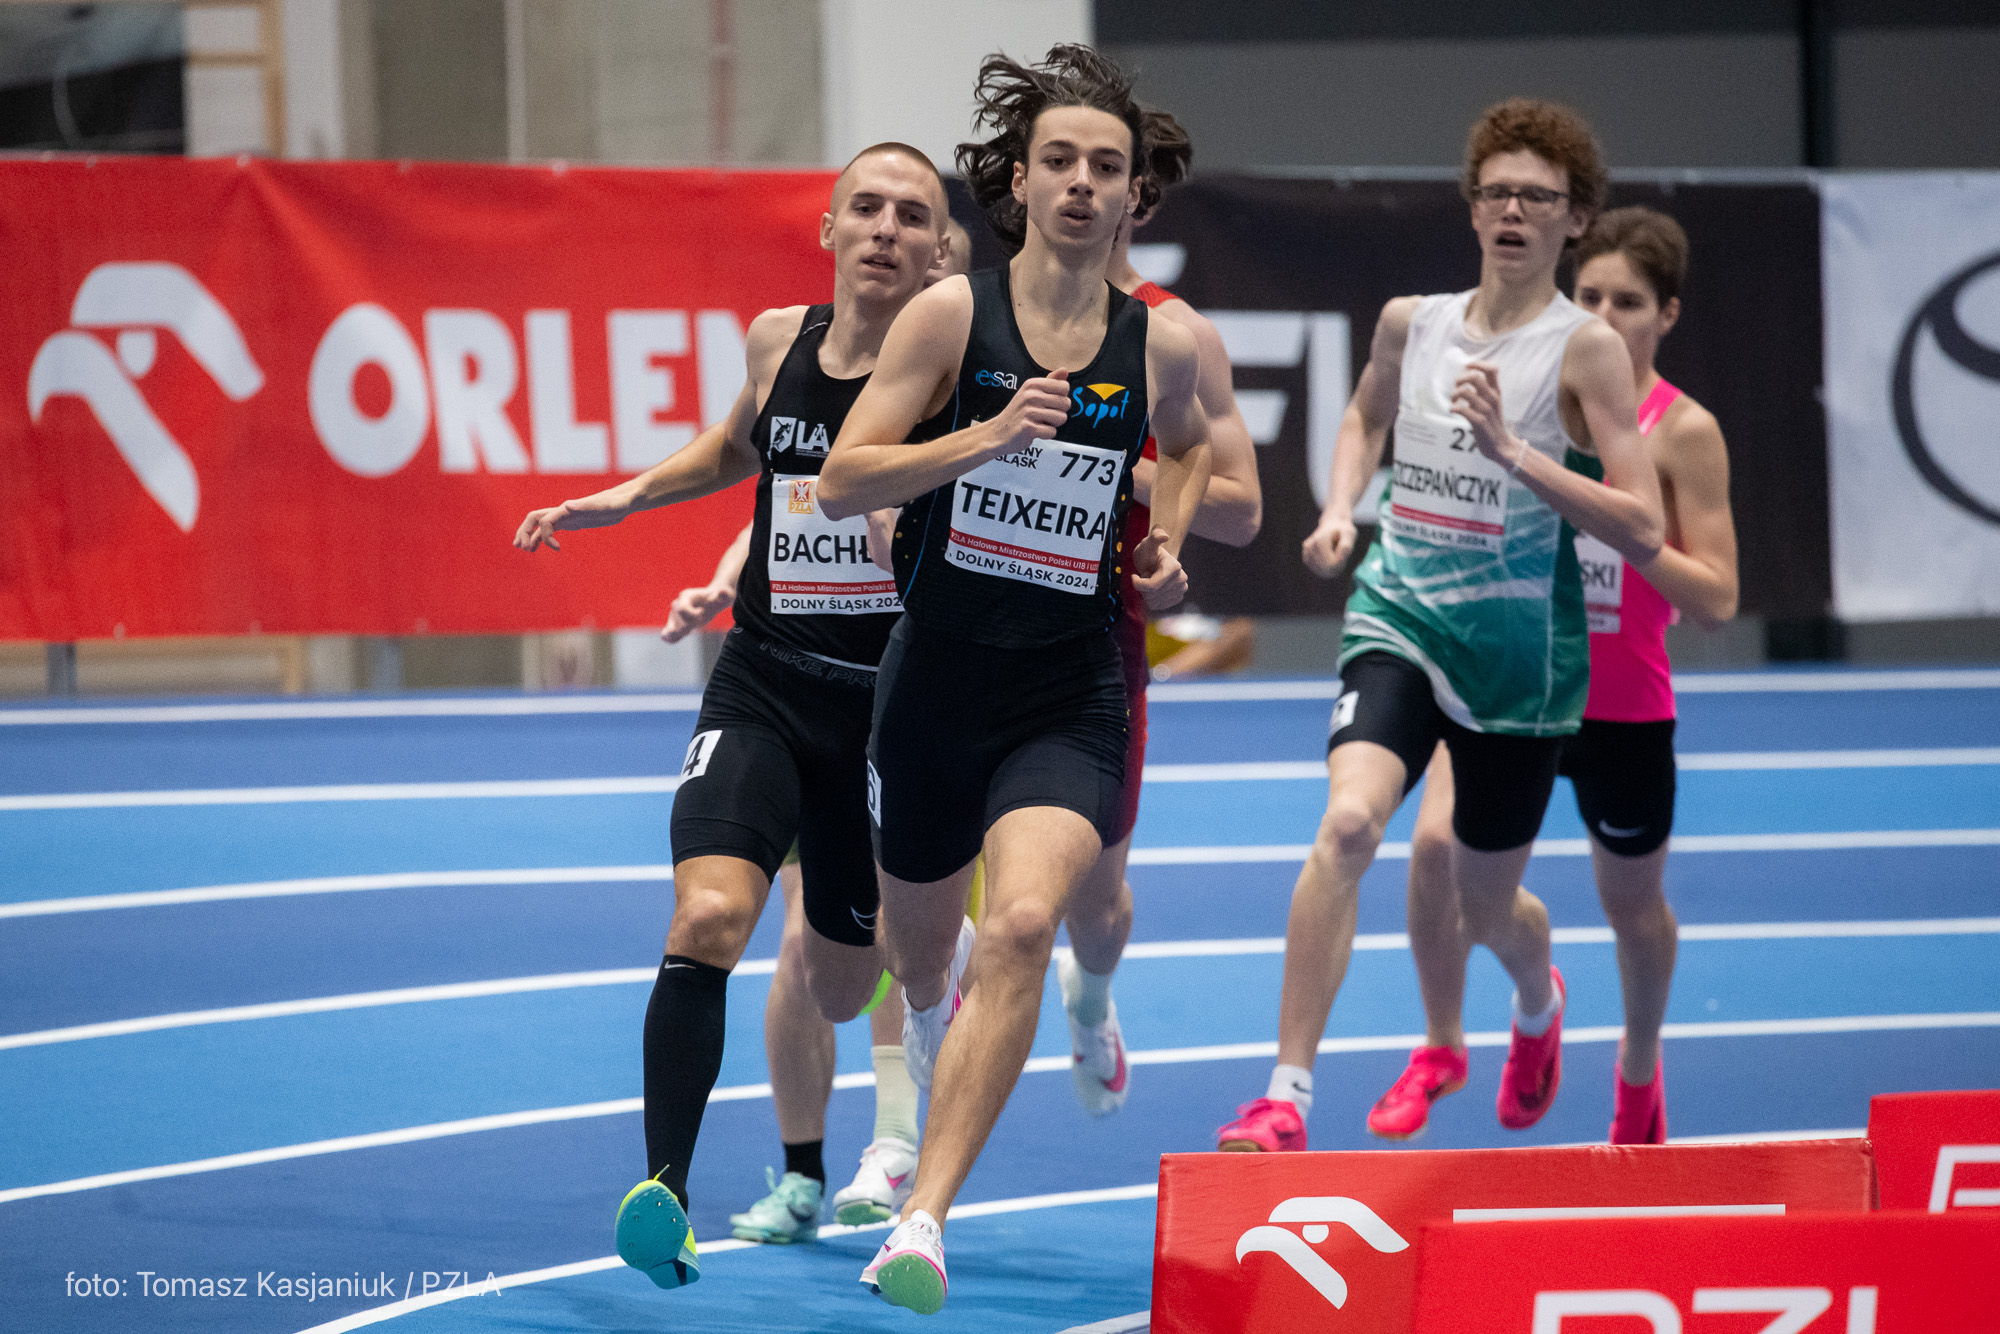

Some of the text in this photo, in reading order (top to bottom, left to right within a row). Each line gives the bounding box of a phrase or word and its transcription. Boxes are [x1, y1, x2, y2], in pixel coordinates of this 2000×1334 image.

[1071, 386, 1130, 429] Sopot
[1059, 451, 1116, 486] 773
[790, 502, 813, 513] PZLA
[960, 481, 1106, 542] TEIXEIRA
[951, 531, 966, 544] PZLA
[967, 538, 998, 551] Halowe
[999, 546, 1047, 562] Mistrzostwa
[1049, 556, 1072, 568] Polski
[956, 550, 1088, 588] DOLNY ŚLĄSK 2024
[772, 583, 786, 591] PZLA
[788, 584, 816, 592] Halowe
[817, 585, 861, 593] Mistrzostwa
[863, 583, 886, 592] Polski
[781, 598, 825, 610] DOLNY
[829, 597, 872, 612] ŚLĄSK
[760, 639, 878, 688] NIKE PR
[682, 735, 701, 777] 4
